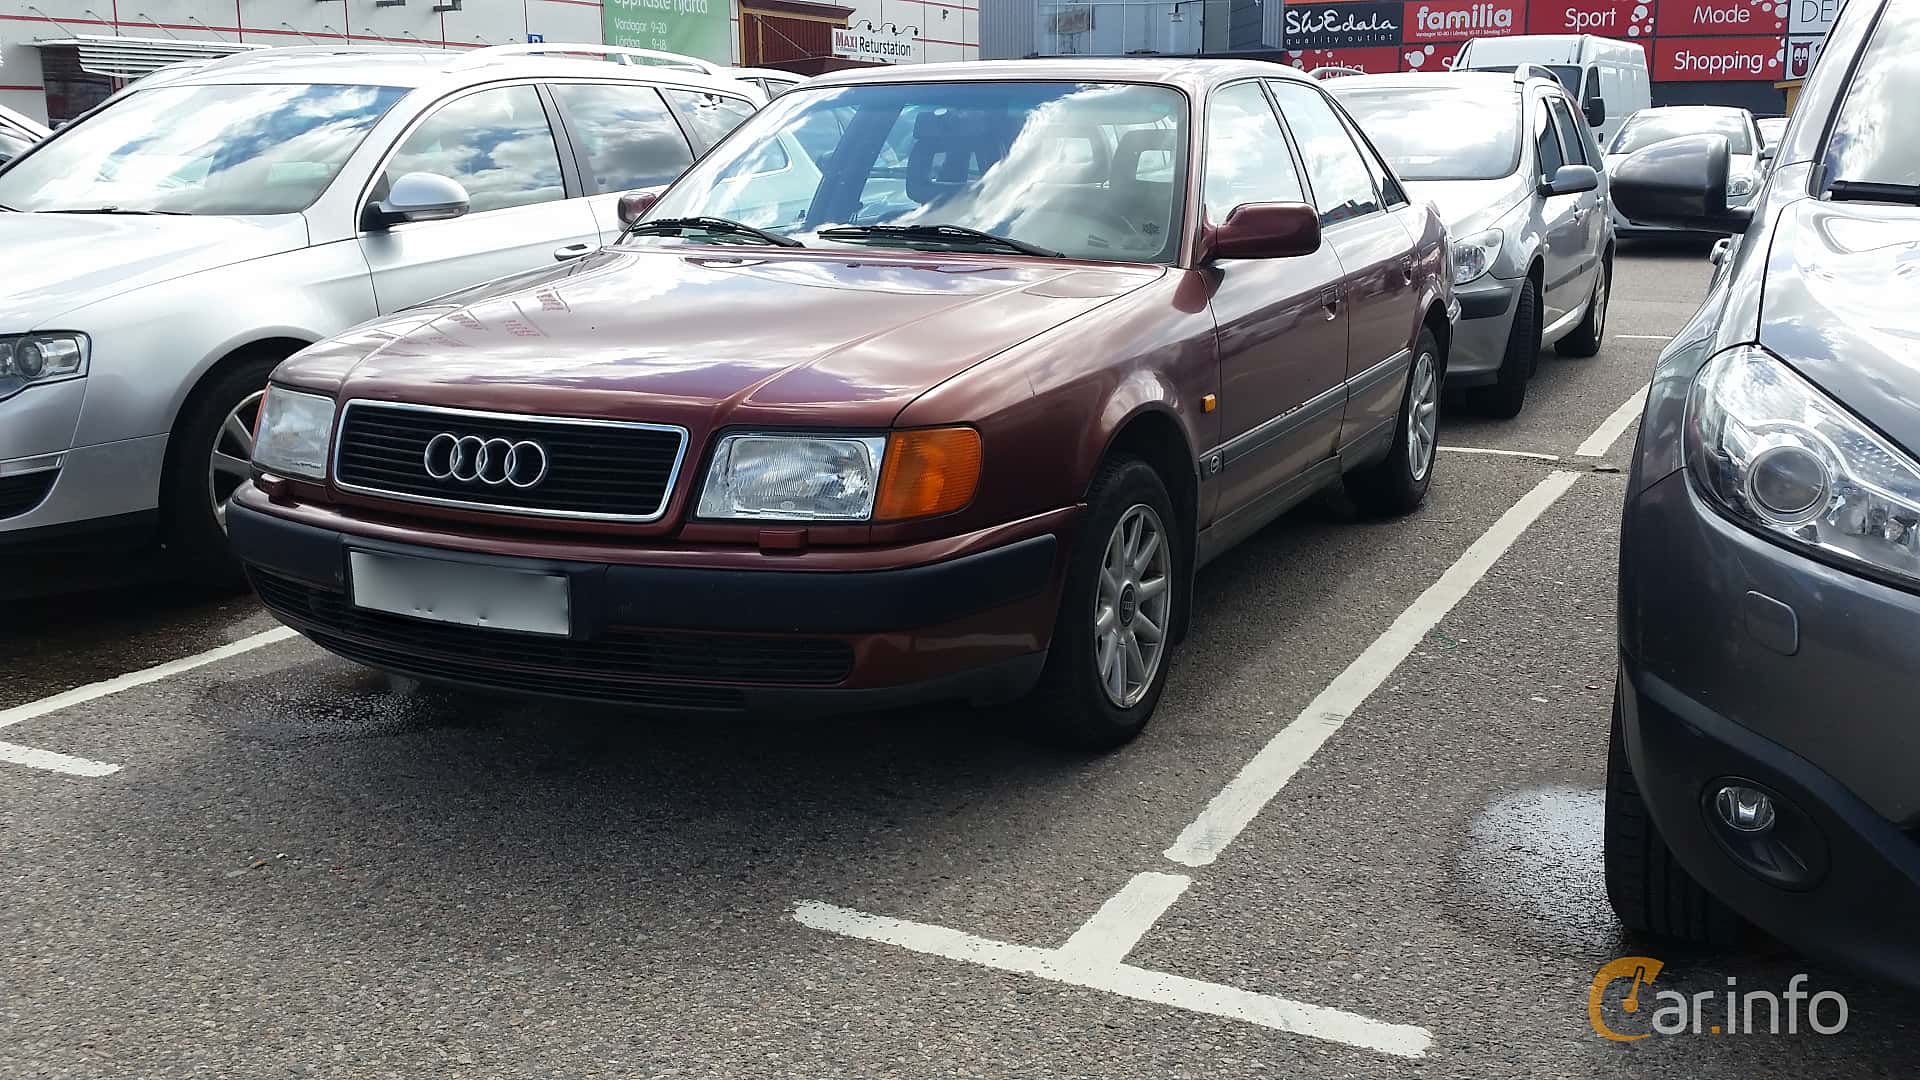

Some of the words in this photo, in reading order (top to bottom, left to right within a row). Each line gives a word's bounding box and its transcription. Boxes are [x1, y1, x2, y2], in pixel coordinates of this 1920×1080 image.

[1417, 3, 1512, 30] familia
[1564, 8, 1616, 32] Sport
[1693, 4, 1750, 24] Mode
[650, 22, 667, 34] 9-20
[859, 36, 911, 56] Returstation
[1286, 34, 1339, 45] quality
[1347, 33, 1393, 42] outlet
[1674, 50, 1763, 74] Shopping
